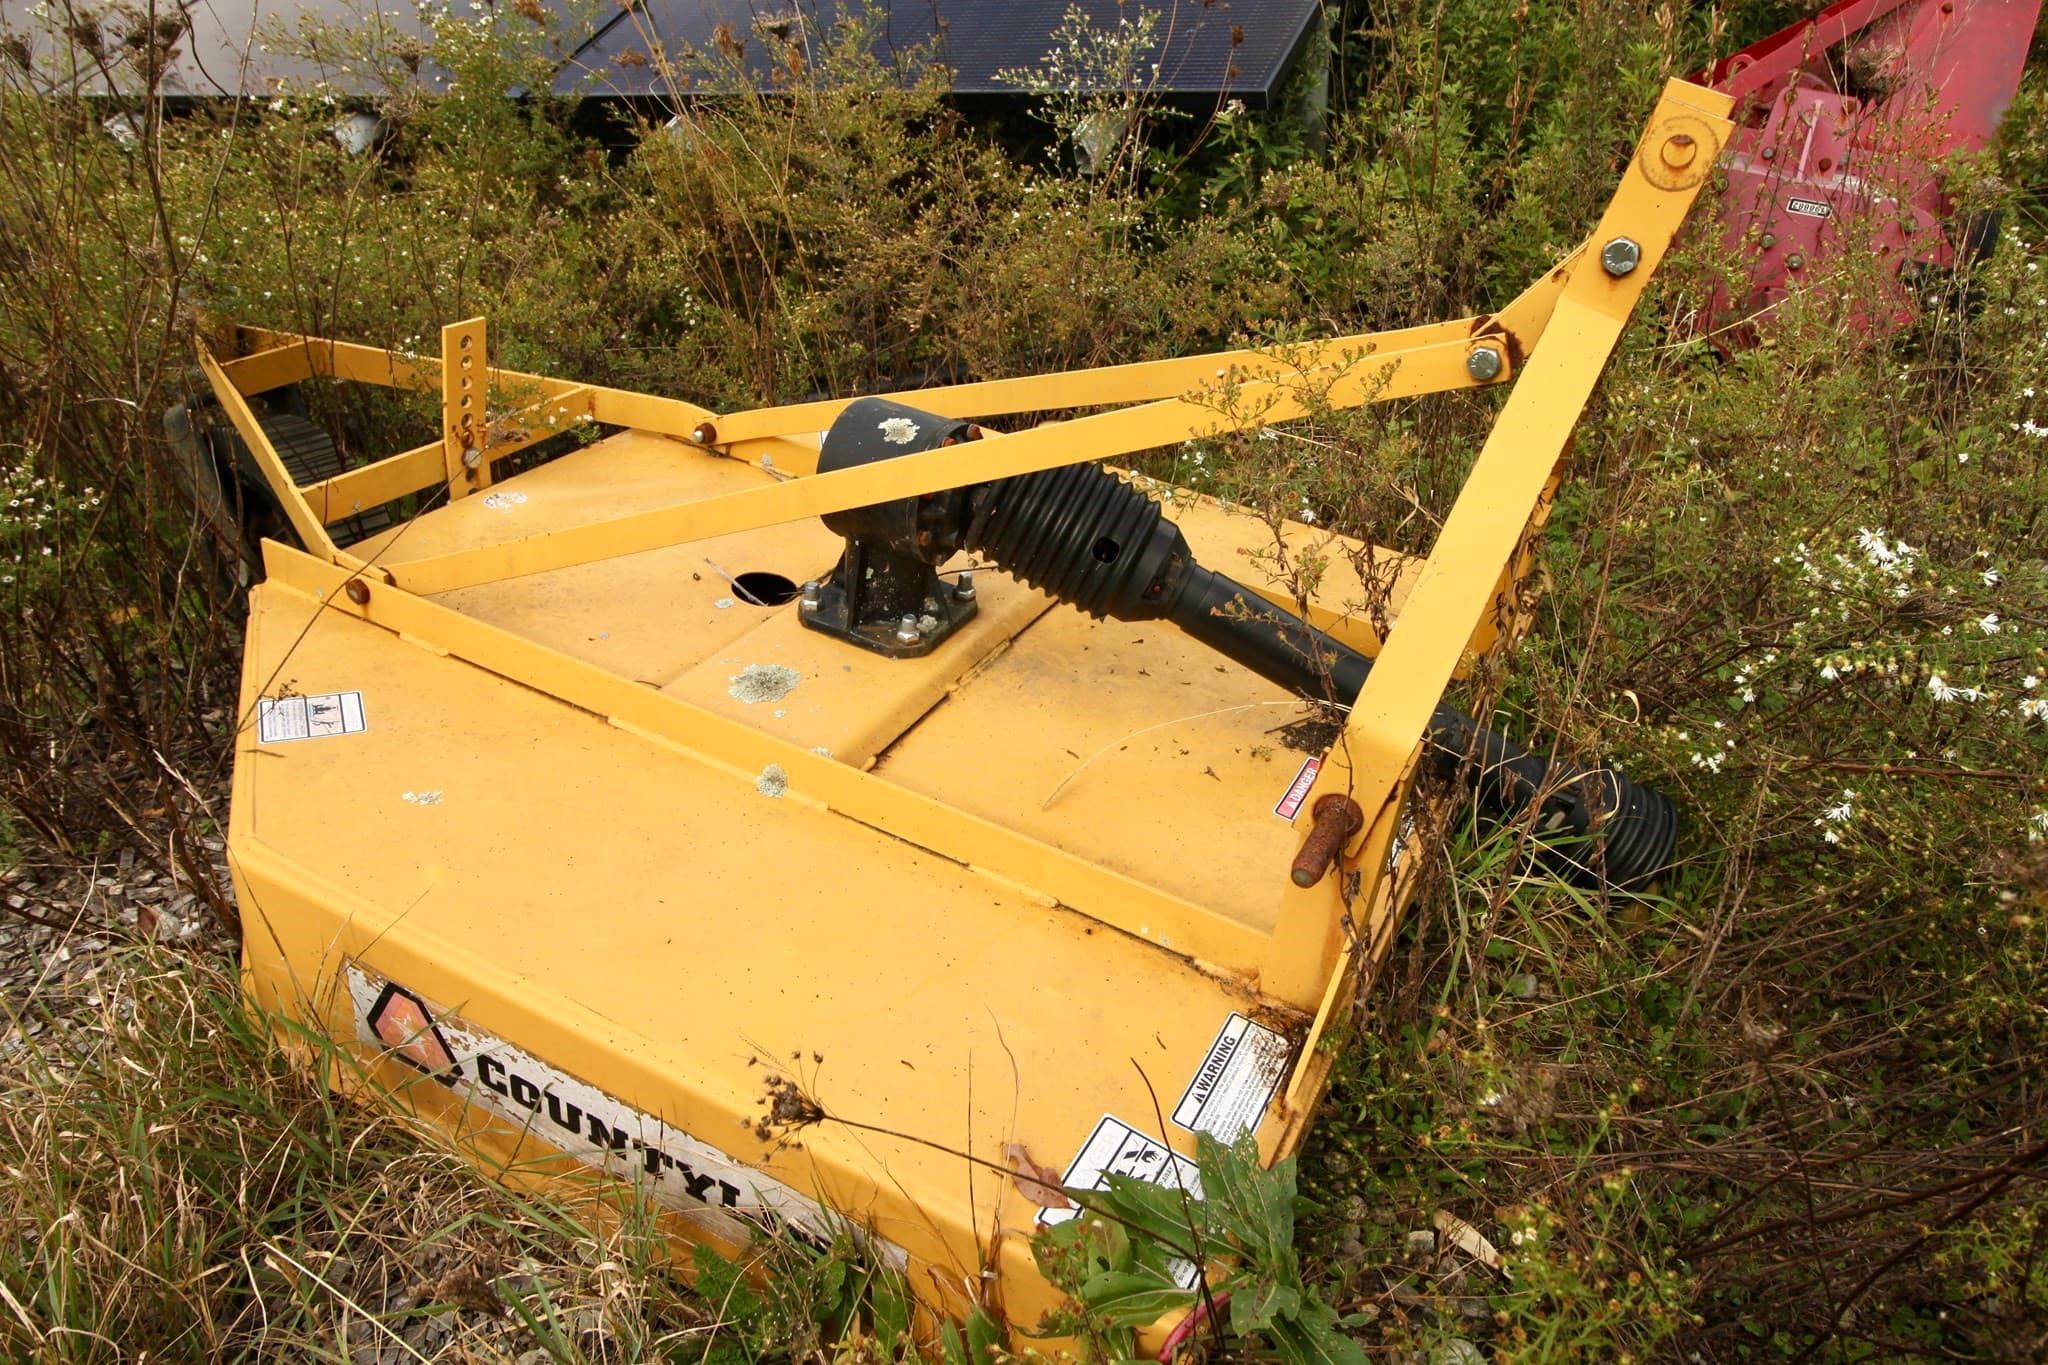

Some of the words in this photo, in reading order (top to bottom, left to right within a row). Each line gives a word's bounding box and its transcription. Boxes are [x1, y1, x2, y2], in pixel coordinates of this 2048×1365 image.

[1293, 767, 1318, 802] DANGER
[1195, 1034, 1236, 1092] WARNING
[477, 1053, 716, 1204] COUNTY
